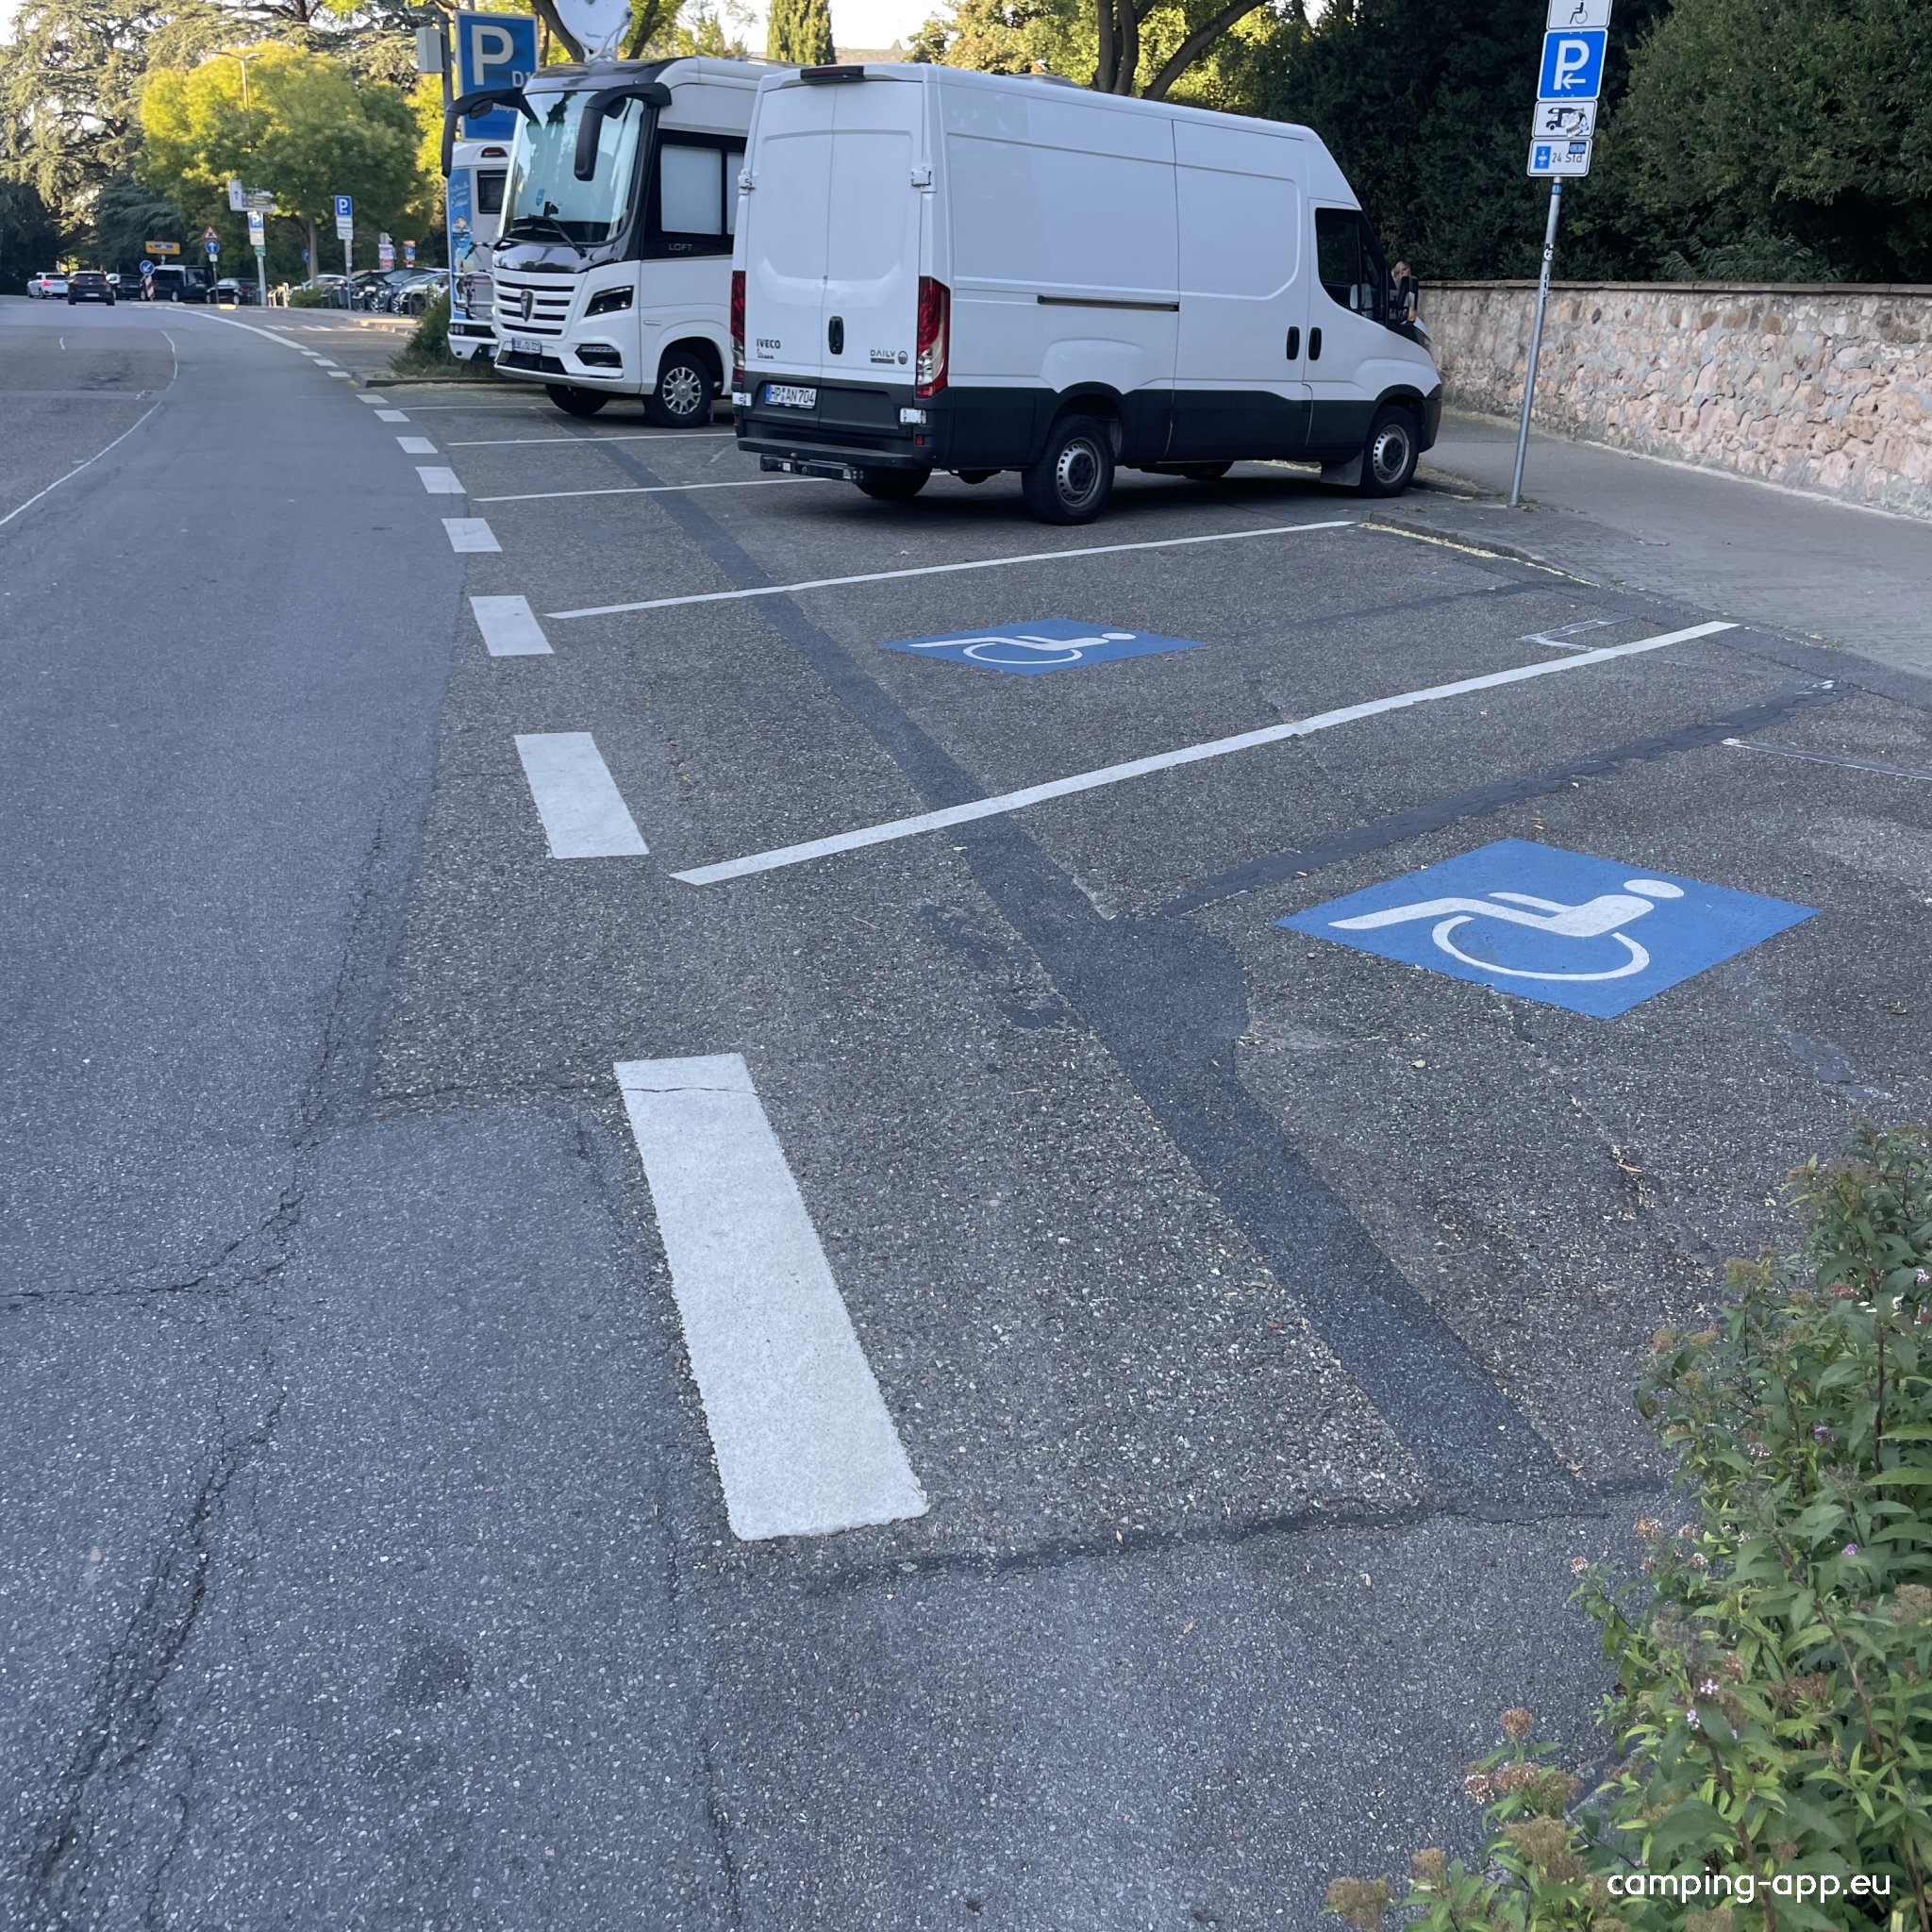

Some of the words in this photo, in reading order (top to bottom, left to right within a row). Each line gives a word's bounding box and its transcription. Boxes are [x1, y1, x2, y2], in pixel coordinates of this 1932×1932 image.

[472, 25, 513, 85] P
[1553, 40, 1590, 91] P
[1552, 153, 1562, 163] 24
[339, 198, 348, 213] P
[668, 243, 693, 252] LOFT
[757, 339, 781, 349] IVECO
[870, 349, 896, 358] DAILY
[770, 387, 782, 401] HP
[799, 390, 815, 404] 704
